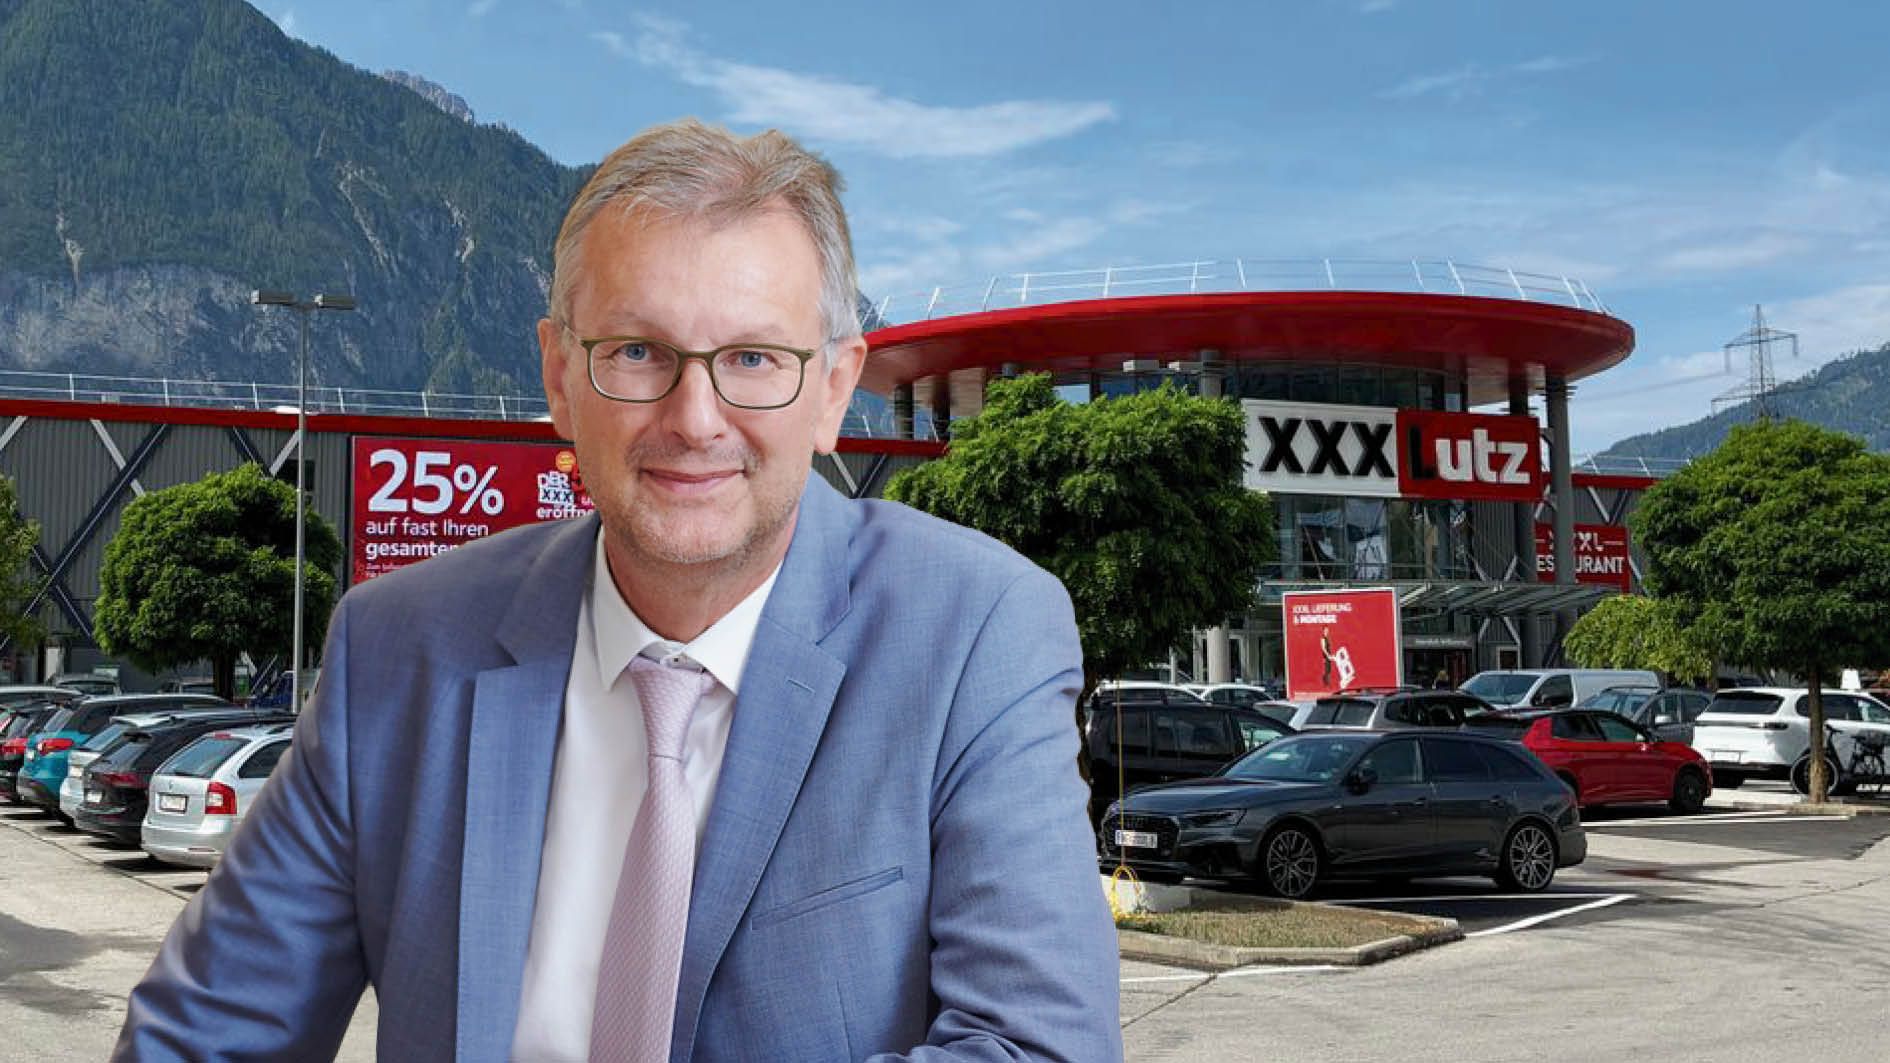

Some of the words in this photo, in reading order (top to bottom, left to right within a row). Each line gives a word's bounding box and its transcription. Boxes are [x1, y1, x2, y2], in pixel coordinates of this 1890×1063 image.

[368, 449, 505, 515] 25%
[366, 517, 397, 535] auf
[402, 517, 437, 536] fast
[443, 519, 489, 536] Ihren
